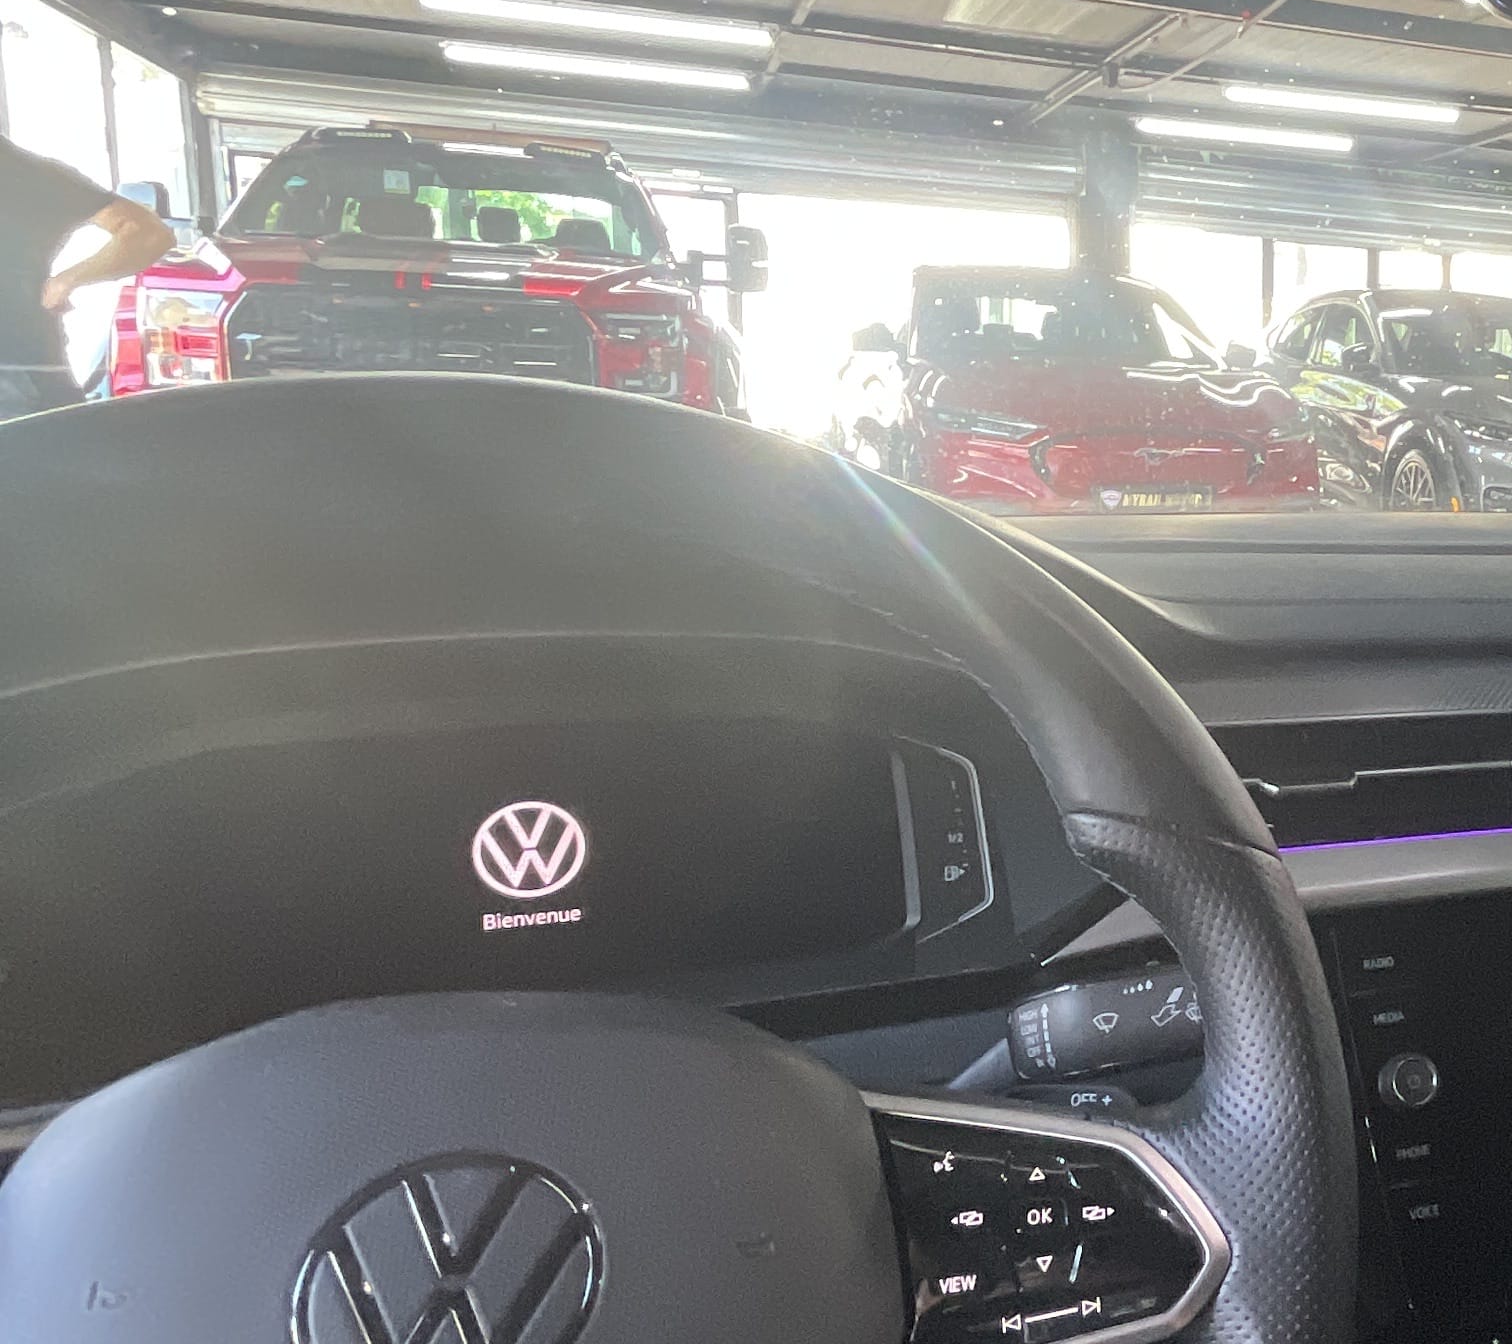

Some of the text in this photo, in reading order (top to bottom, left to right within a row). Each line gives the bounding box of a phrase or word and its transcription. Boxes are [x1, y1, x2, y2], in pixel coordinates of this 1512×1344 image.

[482, 906, 582, 931] Bienvenue
[1027, 1207, 1052, 1226] OK
[938, 1274, 977, 1295] VIEW
